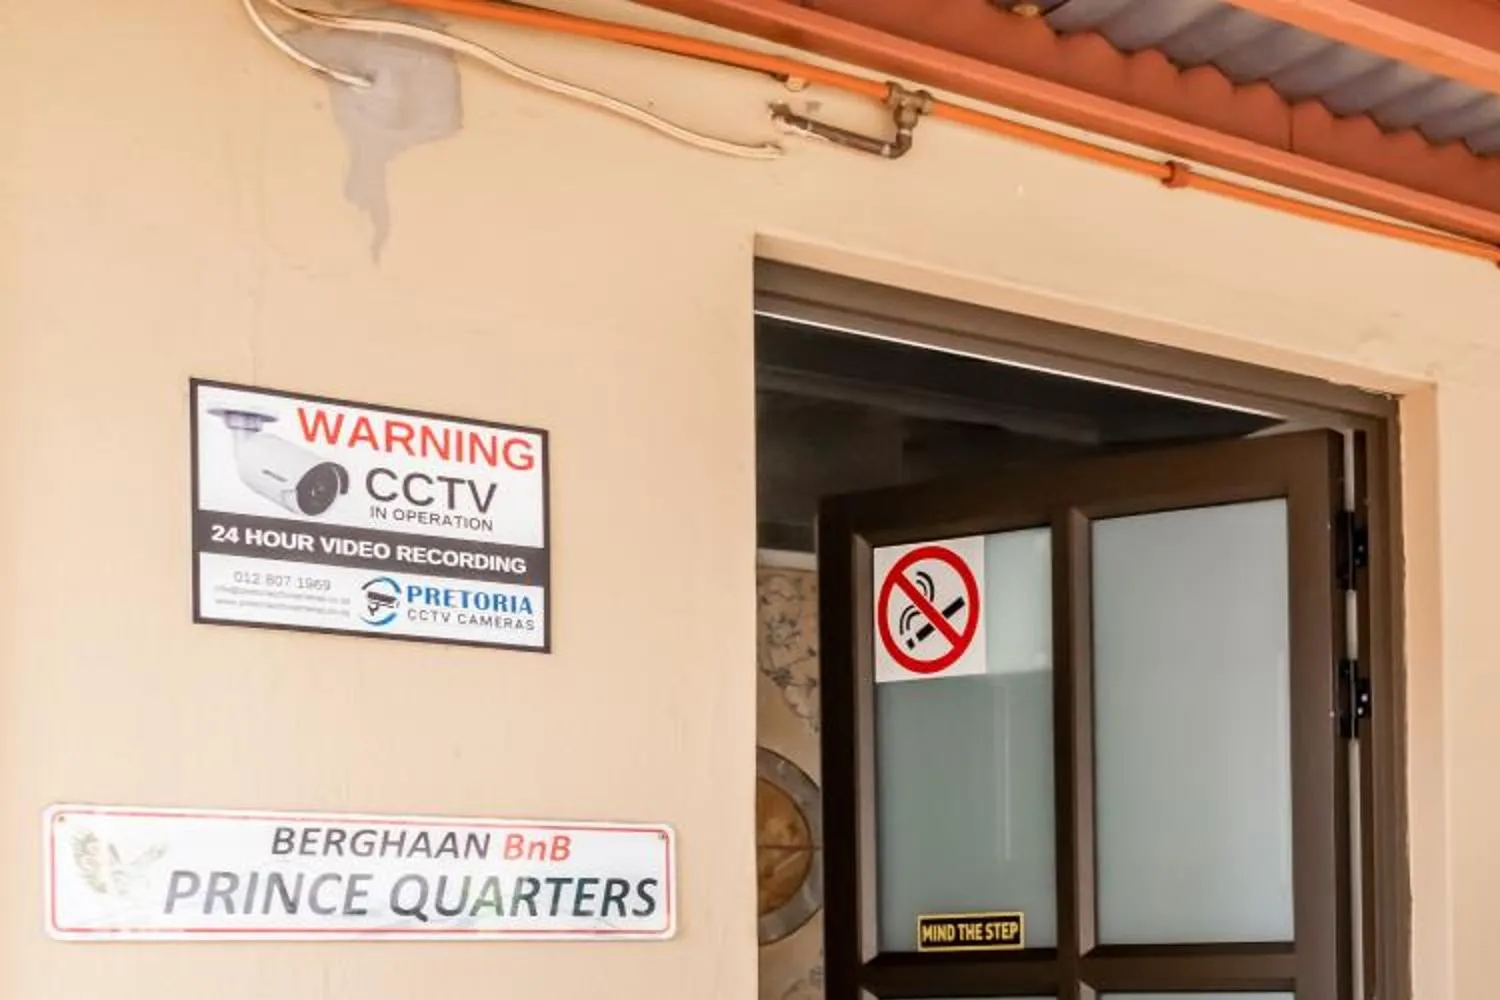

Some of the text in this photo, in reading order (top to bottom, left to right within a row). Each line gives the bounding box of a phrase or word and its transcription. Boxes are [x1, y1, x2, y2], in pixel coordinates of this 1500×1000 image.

[297, 407, 536, 472] WARNING
[365, 466, 498, 514] CCTV
[370, 505, 494, 532] IN OPERATION
[211, 524, 527, 574] 24 HOUR VIDEO RECORDING
[233, 570, 331, 591] 012 807 1969
[407, 584, 533, 615] PRETORIA
[407, 608, 536, 632] CCTV CAMERAS
[270, 826, 572, 863] BERGHAAN BnB
[163, 869, 658, 925] PRINCE QUARTERS
[922, 921, 1019, 942] MIND THE STEP
